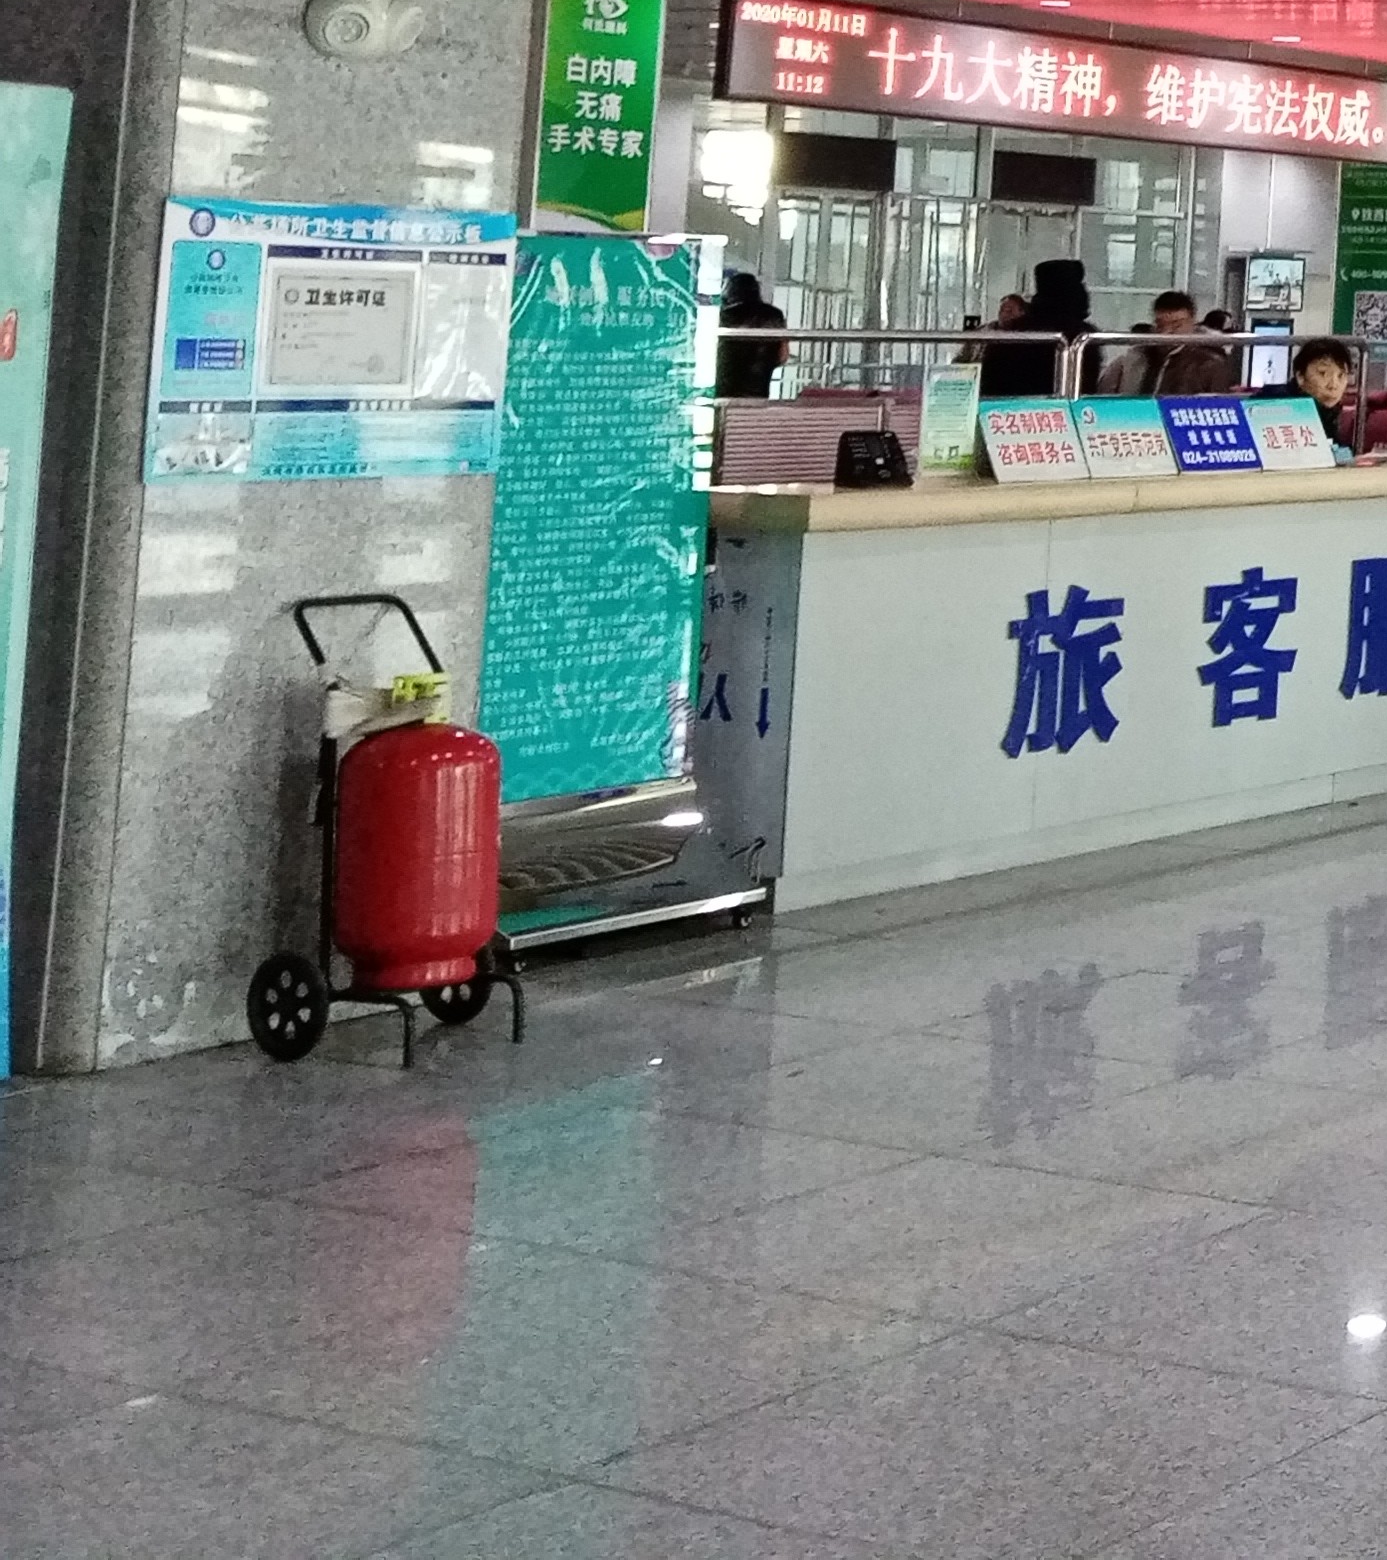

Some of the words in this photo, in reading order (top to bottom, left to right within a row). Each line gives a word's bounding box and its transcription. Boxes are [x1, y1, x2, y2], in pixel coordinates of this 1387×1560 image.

[741, 1, 867, 37] 2020年01月11日
[776, 36, 830, 64] 星期六
[567, 53, 638, 88] 白内障
[776, 72, 825, 95] 11:12
[575, 91, 623, 122] 无痛
[548, 124, 644, 159] 手术专家
[304, 288, 386, 307] 卫生许可证
[987, 410, 1068, 435] 实名制购票
[1087, 432, 1168, 458] 共产党员示范岗
[1262, 425, 1318, 448] 退票处
[997, 440, 1076, 466] 咨询服务台
